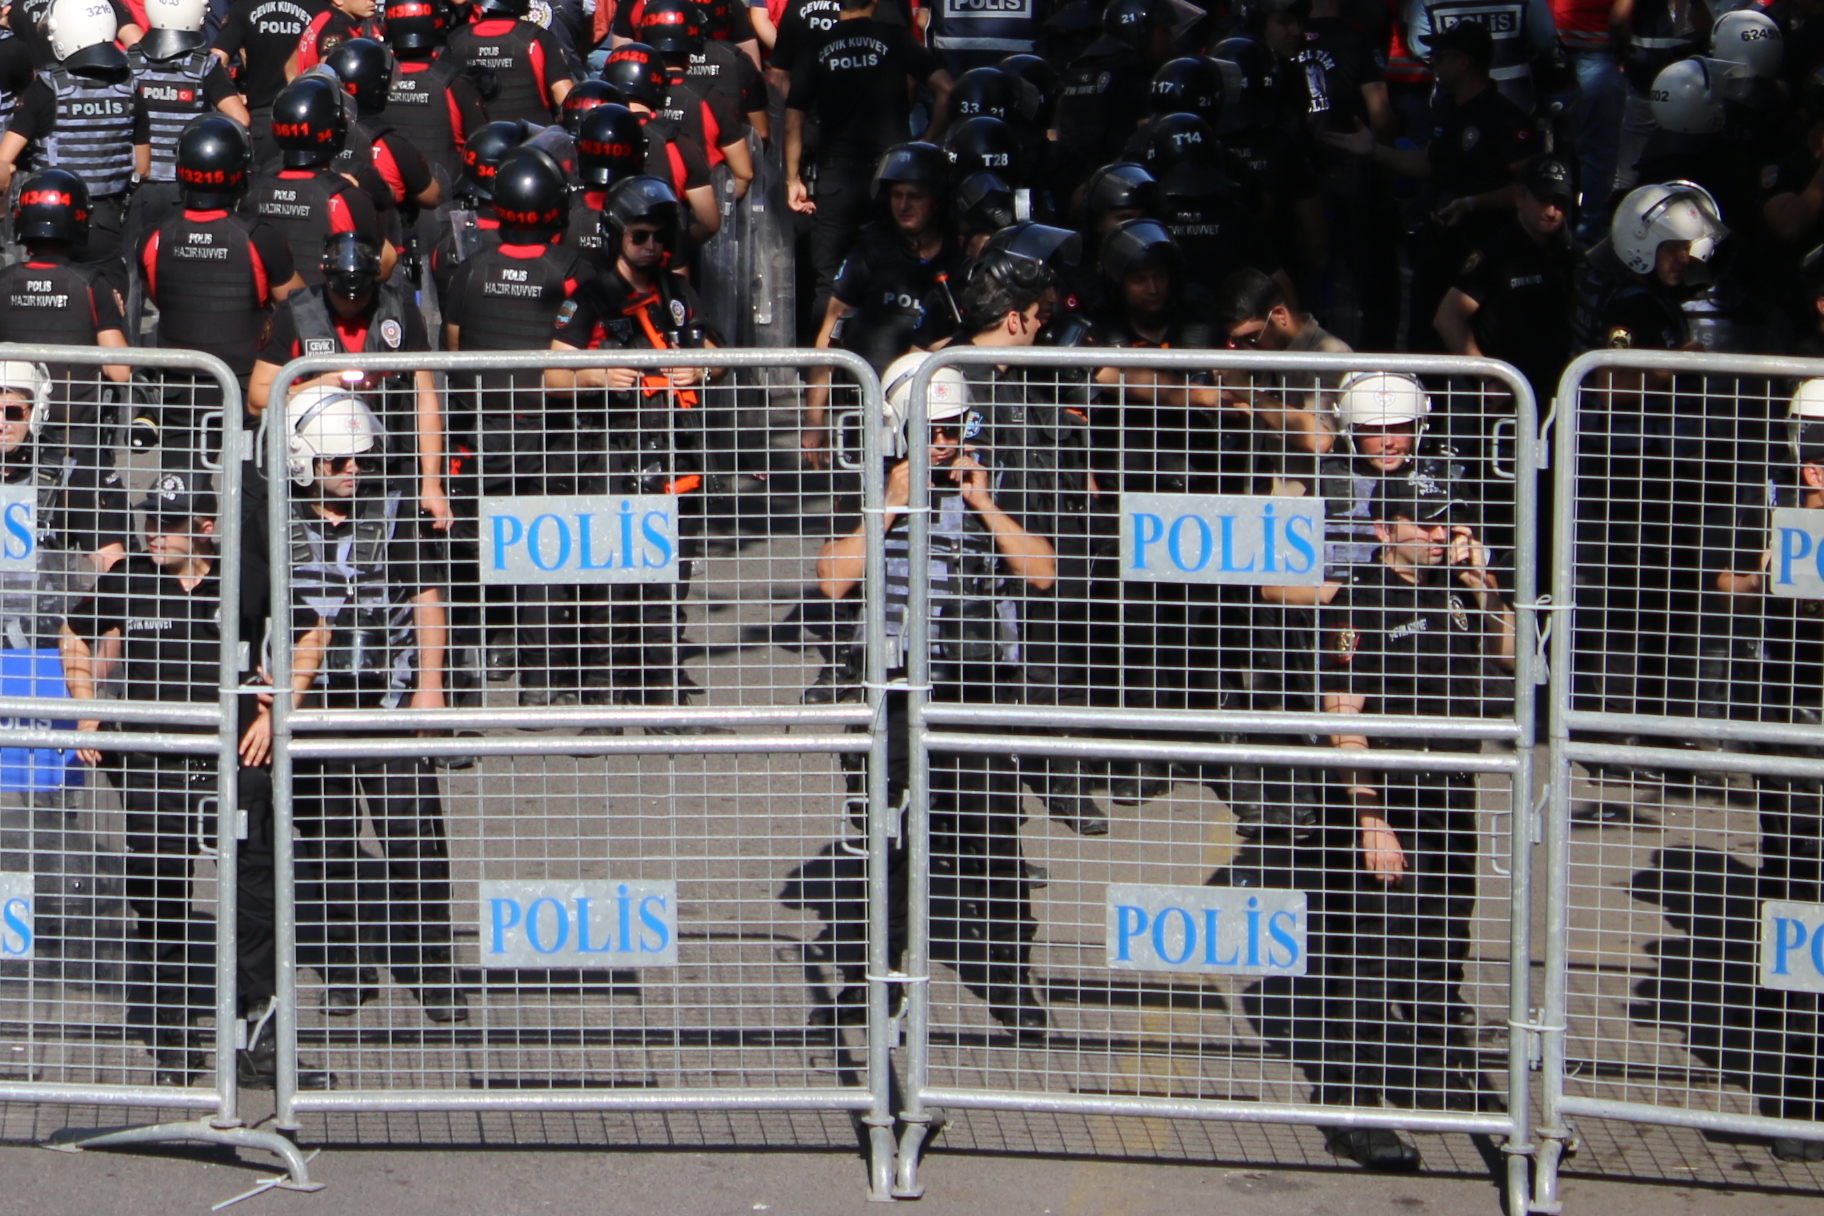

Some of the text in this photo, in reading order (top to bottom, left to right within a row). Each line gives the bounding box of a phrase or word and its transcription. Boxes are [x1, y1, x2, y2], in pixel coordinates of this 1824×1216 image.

[86, 3, 113, 18] 3216
[250, 0, 313, 25] ÇEVİK KUVVET
[798, 0, 831, 20] ÇEVİK
[1120, 12, 1136, 25] 21
[817, 36, 890, 63] ÇEVİK KUVVET
[490, 57, 513, 68] KUVVET
[143, 86, 178, 101] POLİS
[71, 99, 124, 116] POLİS
[1171, 131, 1203, 147] T14
[981, 152, 1010, 168] T28
[478, 164, 495, 178] 34
[259, 203, 311, 217] HAZIR KUVVET
[174, 246, 229, 260] HAZIR KUVVET
[484, 282, 543, 298] HAZIR KUVVET
[10, 294, 69, 309] HAZIR KUVVET
[308, 340, 332, 352] ÇEVİK
[491, 500, 672, 572] POLİS
[1132, 502, 1317, 574] POLİS
[490, 883, 670, 953] POLİS
[1116, 896, 1299, 968] POLİS
